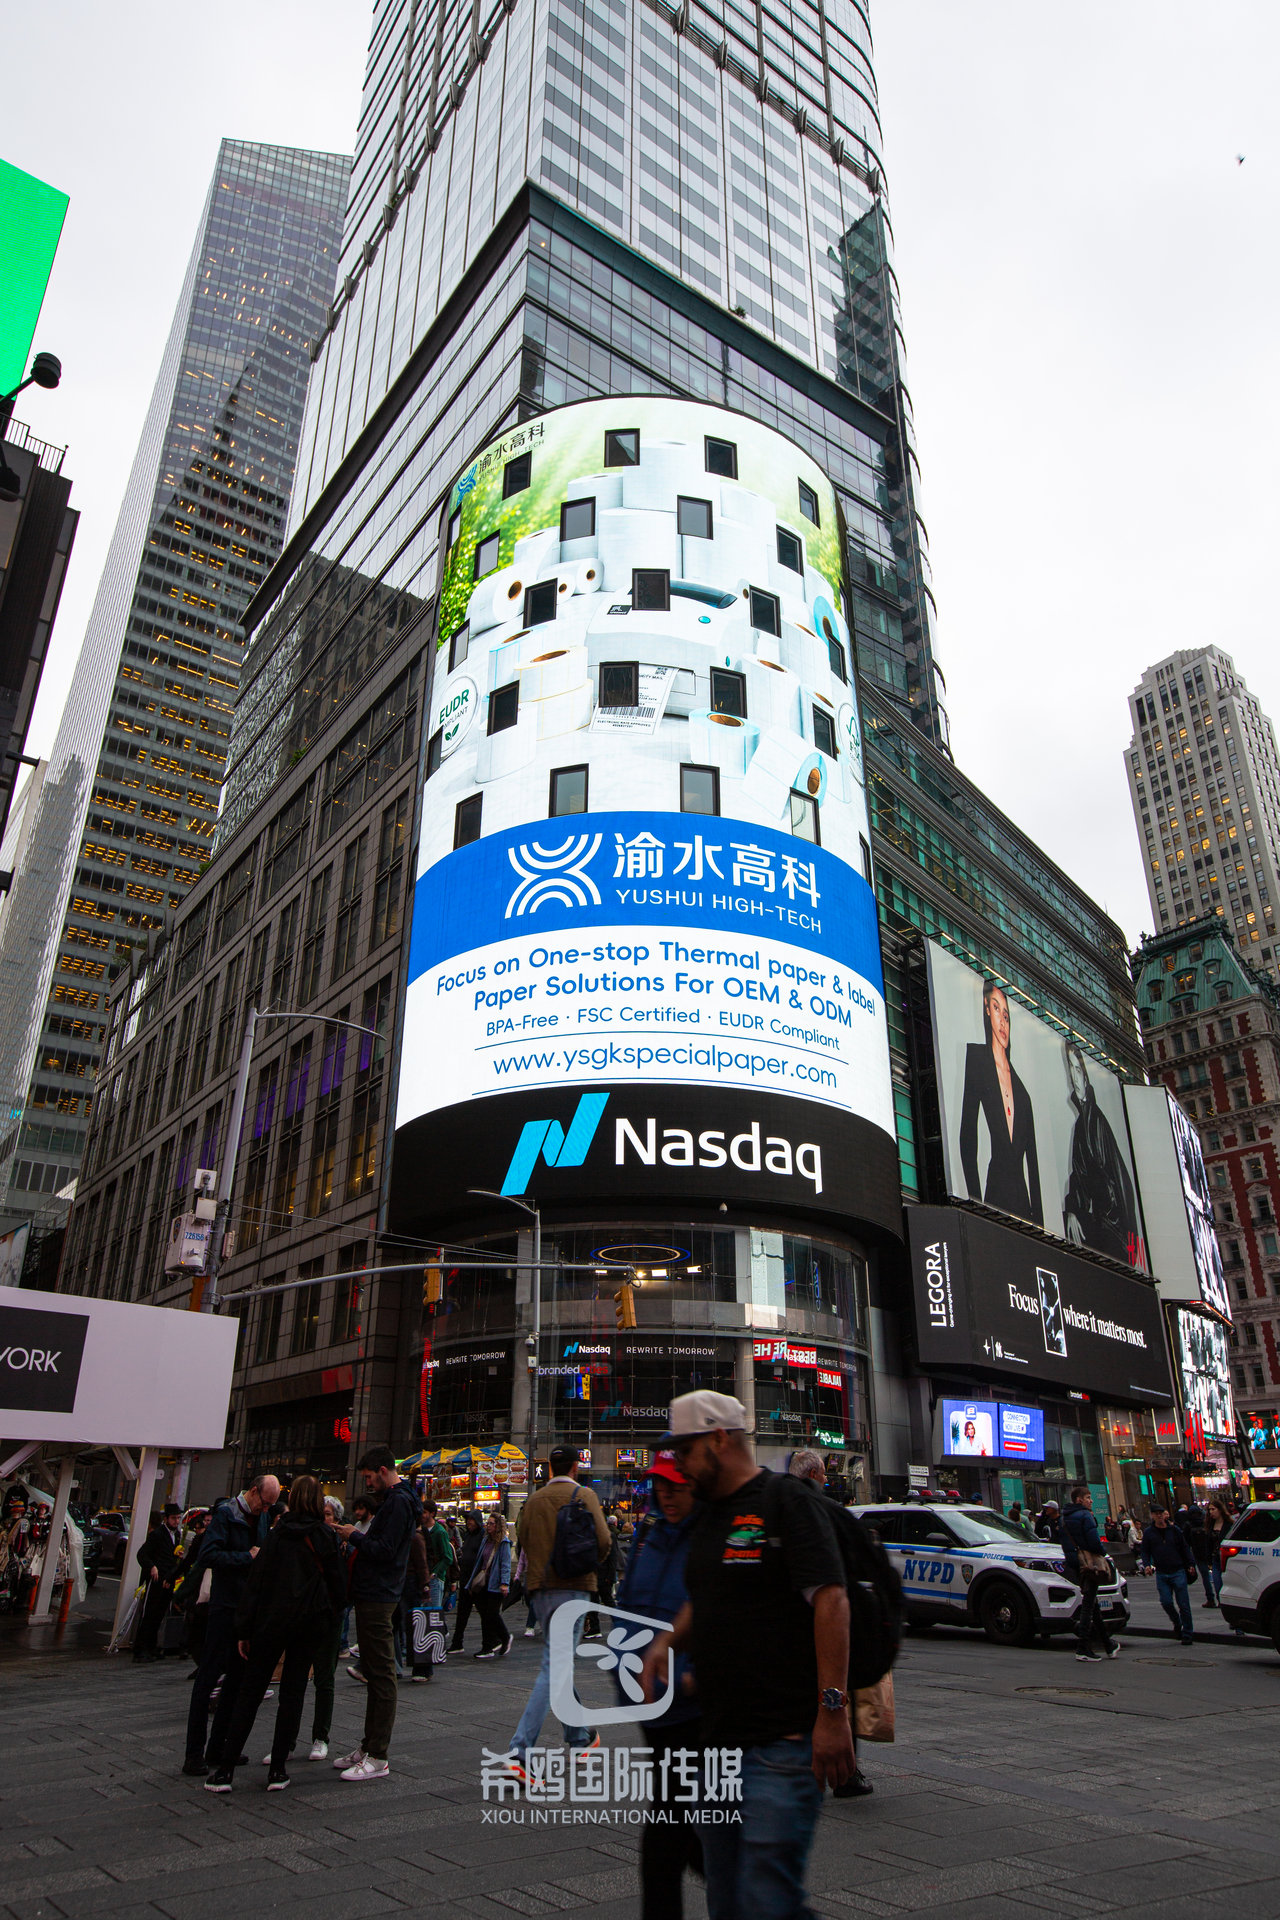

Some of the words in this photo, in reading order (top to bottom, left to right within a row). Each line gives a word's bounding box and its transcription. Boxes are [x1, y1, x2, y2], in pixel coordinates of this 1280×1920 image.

[478, 421, 545, 474] 渝水高科
[439, 688, 470, 724] EUDR
[612, 831, 822, 909] 渝水高科
[615, 889, 704, 907] YUSHUI
[712, 893, 822, 934] HIGH-TECH
[436, 965, 487, 996] Focus
[493, 956, 520, 976] on
[528, 942, 650, 968] One-stop
[658, 940, 760, 970] Thermal
[768, 958, 826, 988] paper
[832, 974, 844, 996] &
[848, 982, 876, 1016] label
[474, 983, 537, 1011] Paper
[545, 970, 665, 997] Solutions
[675, 972, 714, 994] For
[723, 977, 780, 1005] OEM
[788, 988, 803, 1010] &
[809, 995, 852, 1028] ODM
[486, 1014, 559, 1037] BPA-Free
[577, 1006, 613, 1024] FSC
[619, 1006, 700, 1023] Certified
[718, 1011, 764, 1031] EUDR
[769, 1019, 841, 1051] Compliant
[492, 1041, 838, 1089] www.ysgkspecialpaper.com
[614, 1117, 823, 1195] Nasdaq
[924, 1241, 947, 1328] LEGORA
[1007, 1282, 1040, 1316] Focus
[1062, 1304, 1090, 1331] where
[1088, 1310, 1098, 1334] it
[1096, 1319, 1127, 1344] matters
[1126, 1327, 1148, 1349] most.
[445, 1355, 468, 1365] REWRITE
[469, 1351, 506, 1362] TOMORROW
[578, 1344, 611, 1356] Nasdaq
[626, 1346, 664, 1355] REWRITE
[667, 1346, 716, 1356] TOMORROW
[623, 1405, 668, 1420] Nasdaq
[902, 1558, 955, 1585] NYPD
[982, 1552, 1005, 1561] POLICE
